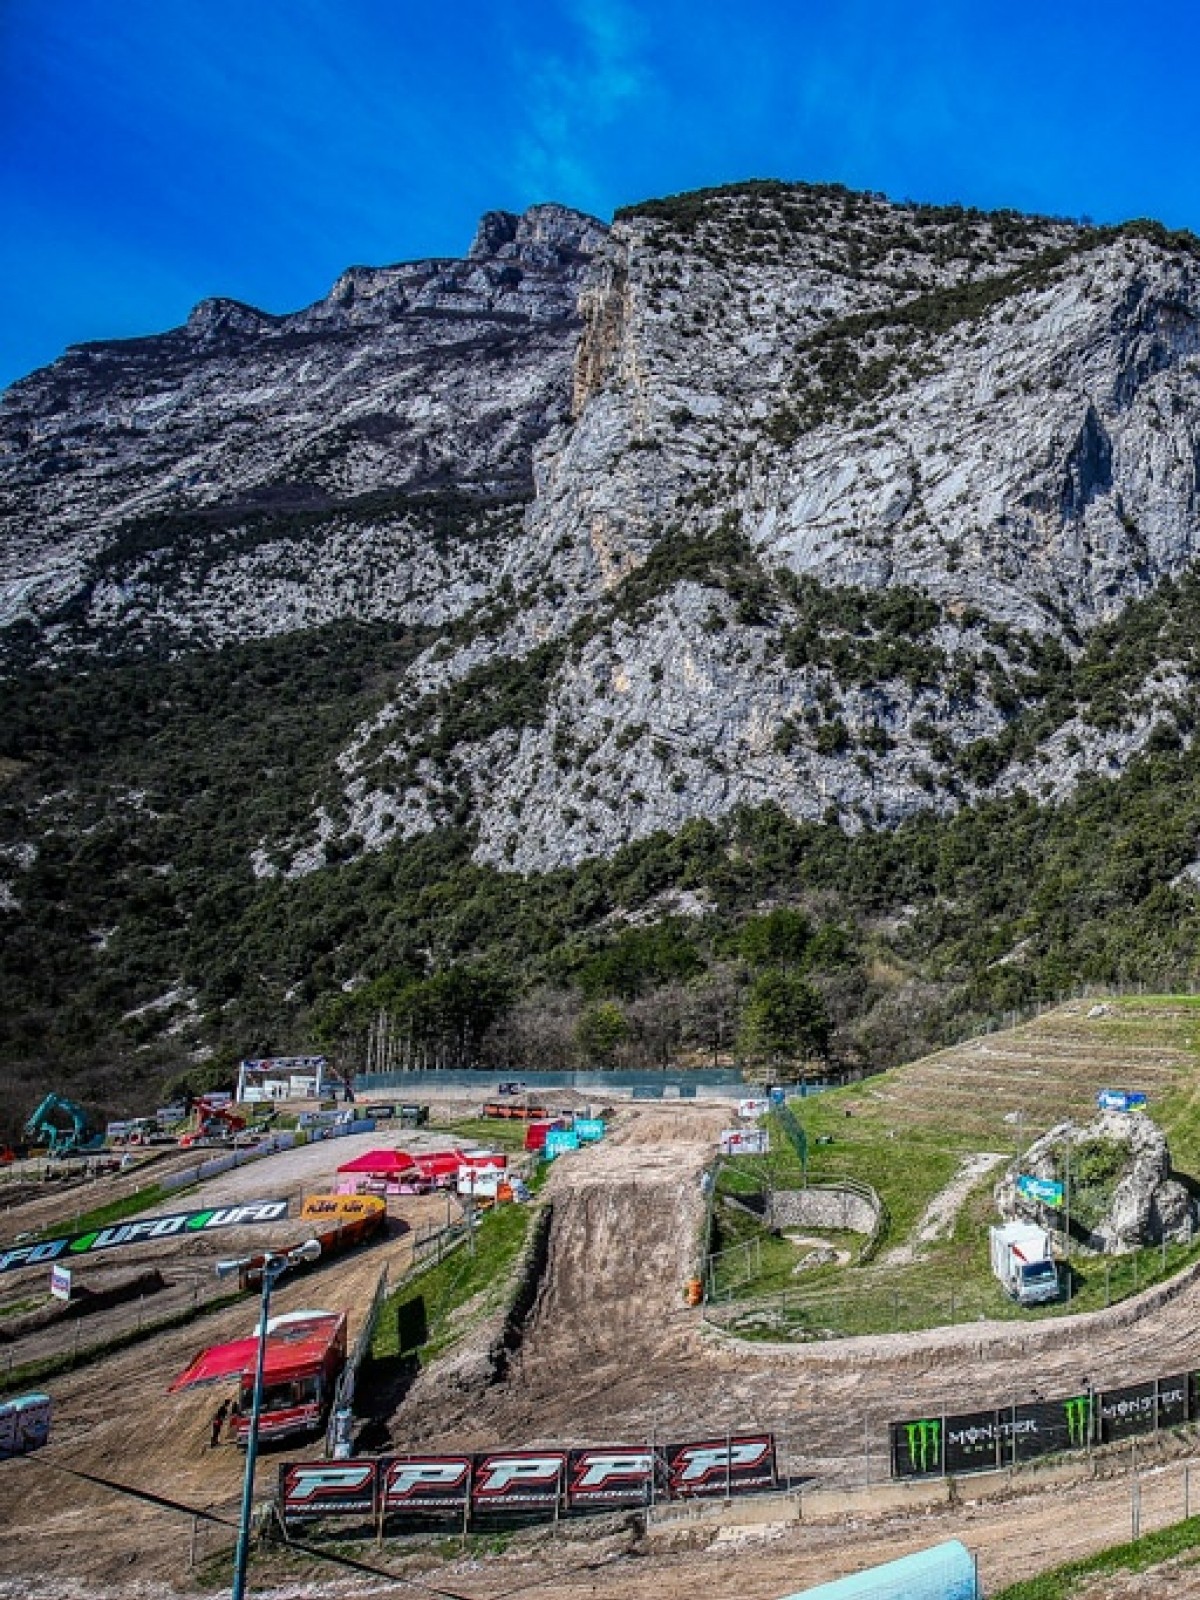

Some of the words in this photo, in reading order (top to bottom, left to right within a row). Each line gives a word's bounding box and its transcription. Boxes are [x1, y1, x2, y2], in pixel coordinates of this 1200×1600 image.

[0, 1240, 68, 1268] FO
[91, 1216, 188, 1248] UFO
[205, 1202, 287, 1227] UFO
